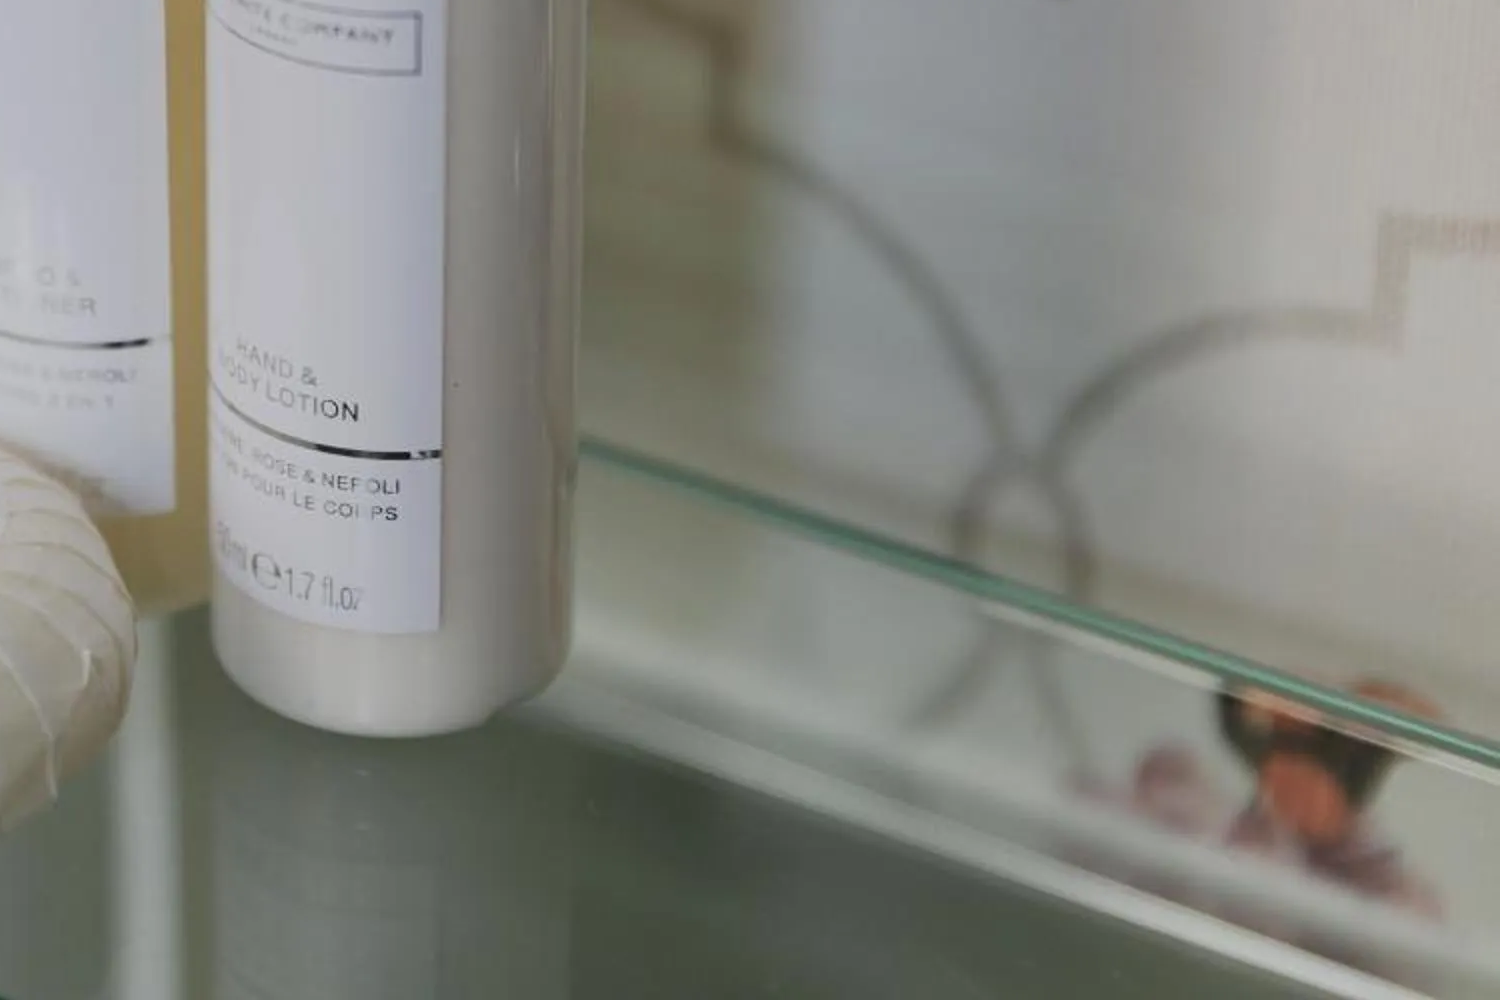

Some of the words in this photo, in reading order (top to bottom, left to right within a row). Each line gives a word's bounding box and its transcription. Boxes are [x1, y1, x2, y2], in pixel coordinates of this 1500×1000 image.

[236, 336, 294, 379] HAND
[301, 366, 318, 387] &
[266, 381, 360, 423] LOTION
[303, 468, 316, 484] &
[293, 490, 317, 511] LE
